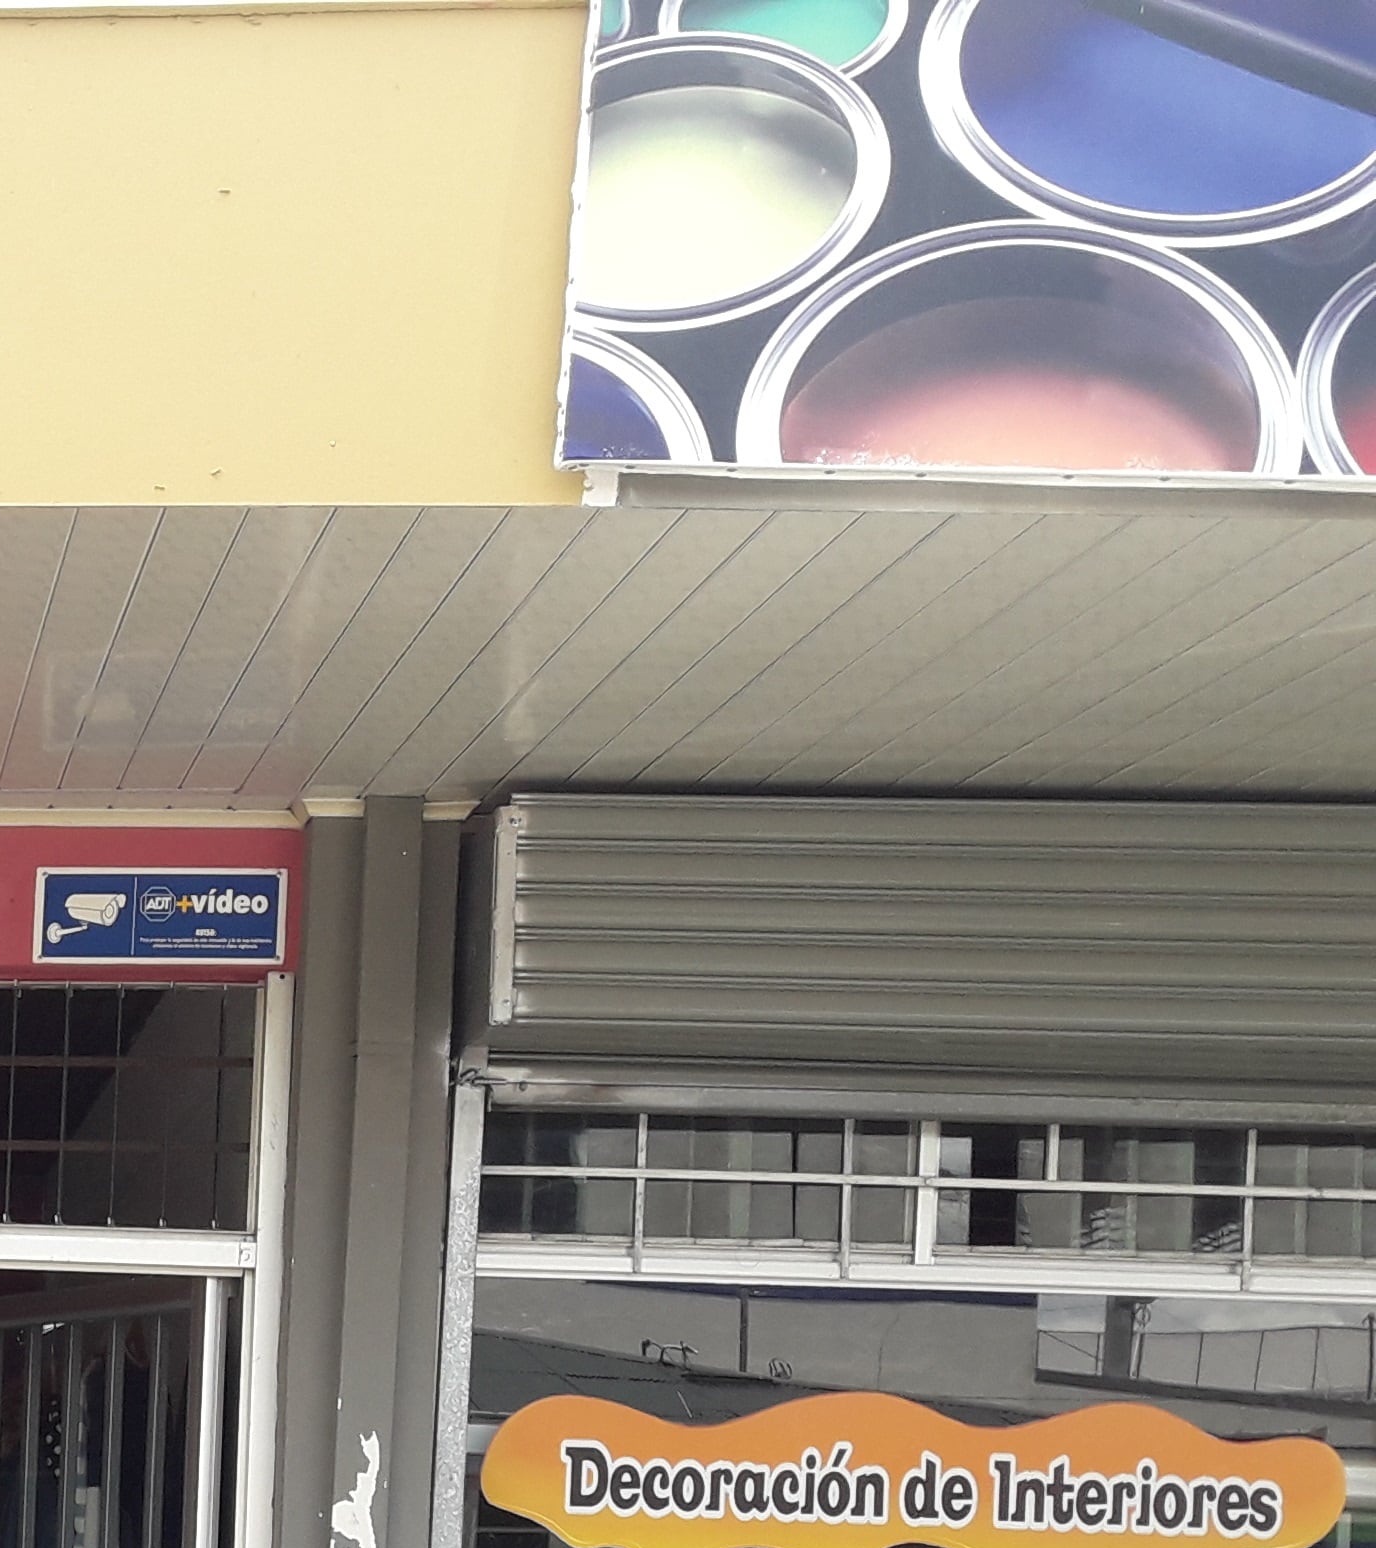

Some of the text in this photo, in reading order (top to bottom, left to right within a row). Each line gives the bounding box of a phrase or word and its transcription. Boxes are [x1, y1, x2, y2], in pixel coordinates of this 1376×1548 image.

[146, 896, 172, 911] ADT
[565, 1443, 1279, 1533] Decoración de Interiores
